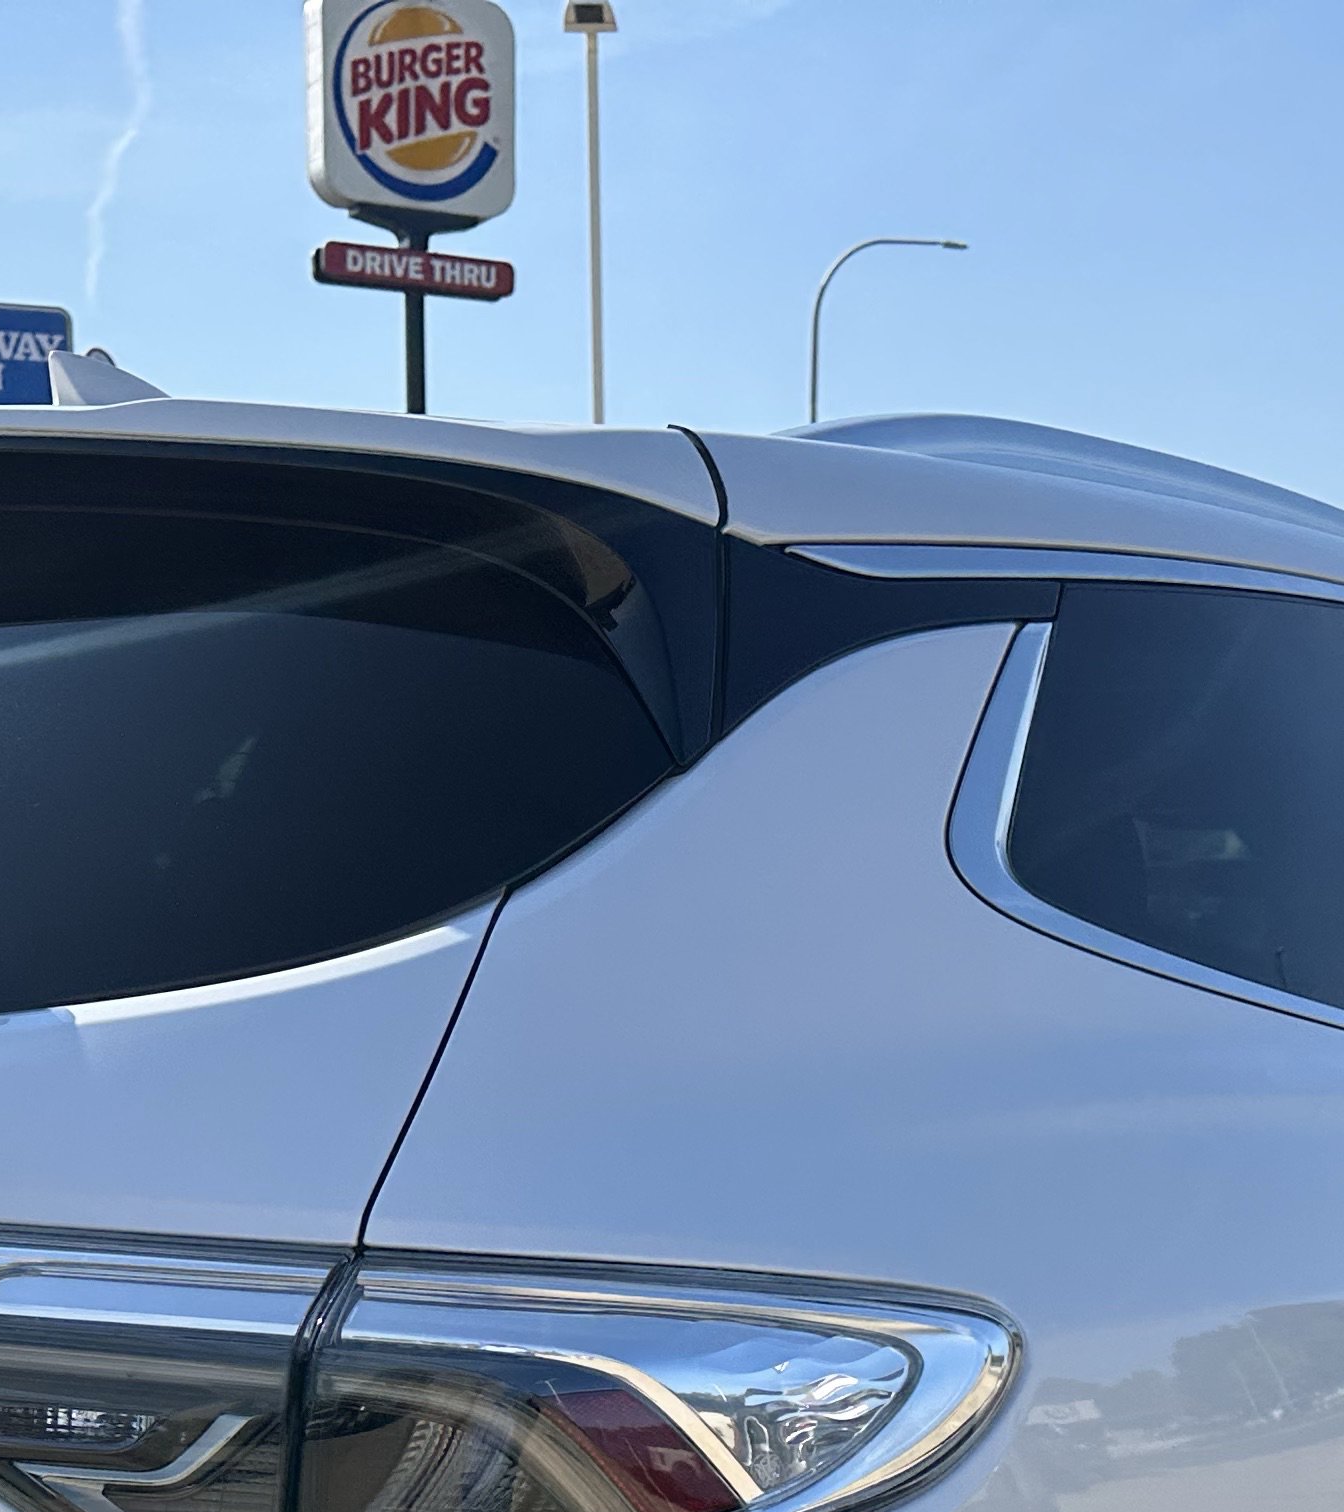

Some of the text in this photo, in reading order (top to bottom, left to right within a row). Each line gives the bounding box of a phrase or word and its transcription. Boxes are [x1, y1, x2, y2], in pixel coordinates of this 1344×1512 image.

[351, 41, 486, 97] BURGER
[358, 77, 492, 151] KING
[345, 249, 498, 288] DRIVE THRU
